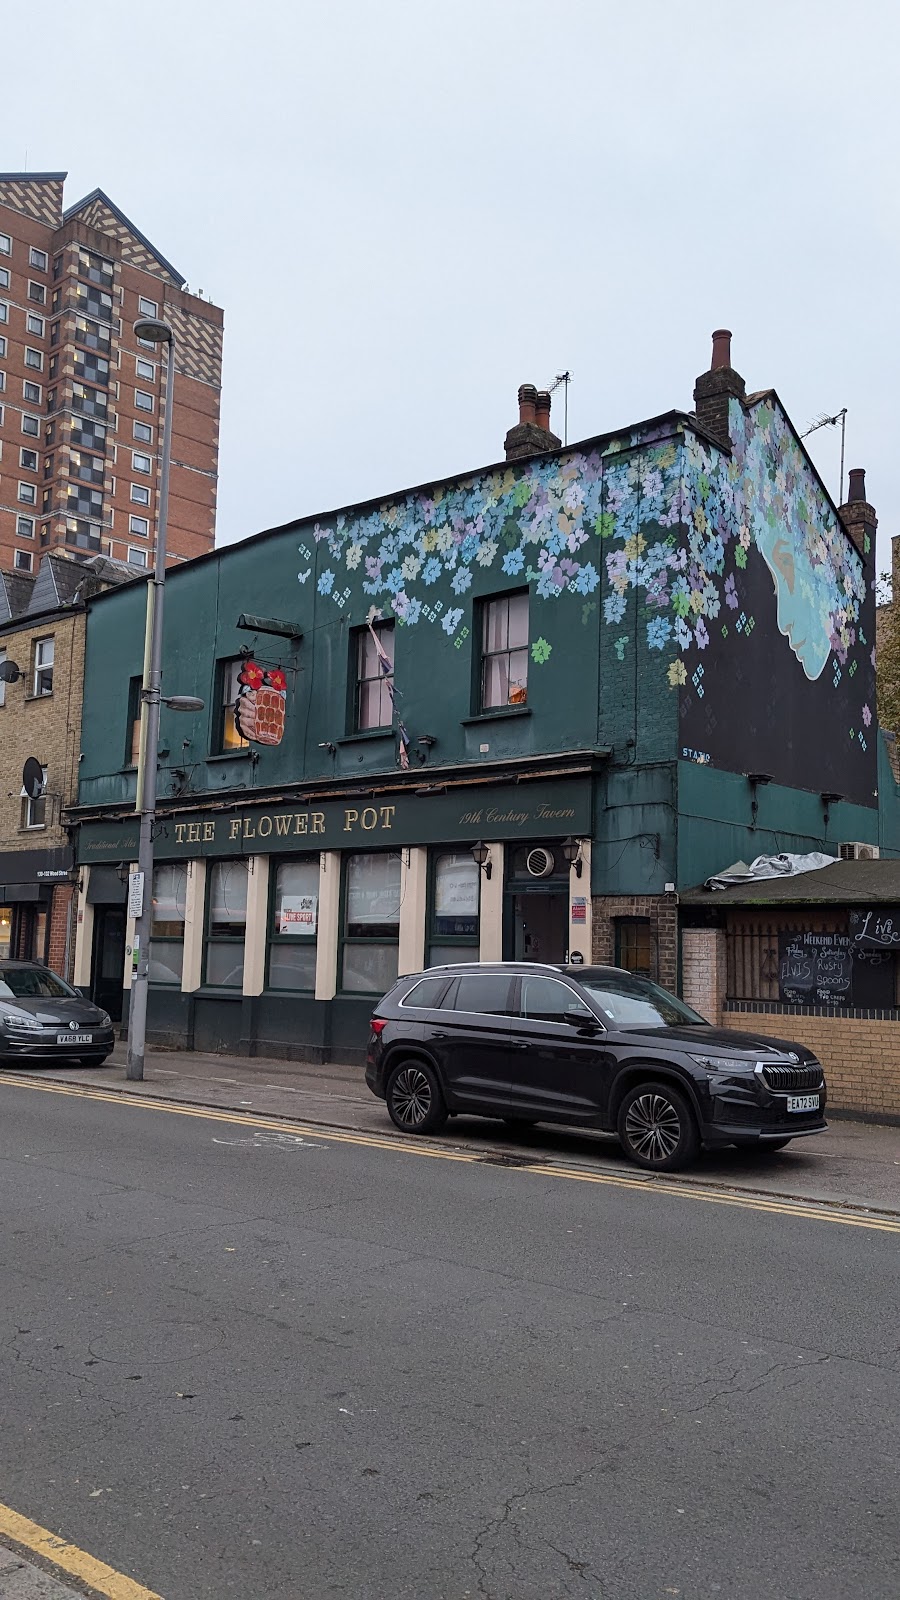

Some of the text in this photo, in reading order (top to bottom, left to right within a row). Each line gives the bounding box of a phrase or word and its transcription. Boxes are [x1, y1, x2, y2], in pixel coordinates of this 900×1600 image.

[459, 803, 576, 826] 19th Century Tavern
[175, 806, 395, 843] THE FLOWER POT
[84, 838, 136, 850] Traditional Ales
[286, 913, 312, 921] LIVE SPORT
[854, 911, 900, 945] Live
[803, 932, 832, 945] WEEKEND
[786, 943, 808, 959] Friday
[820, 946, 847, 961] Saturday
[791, 1097, 808, 1110] EA72
